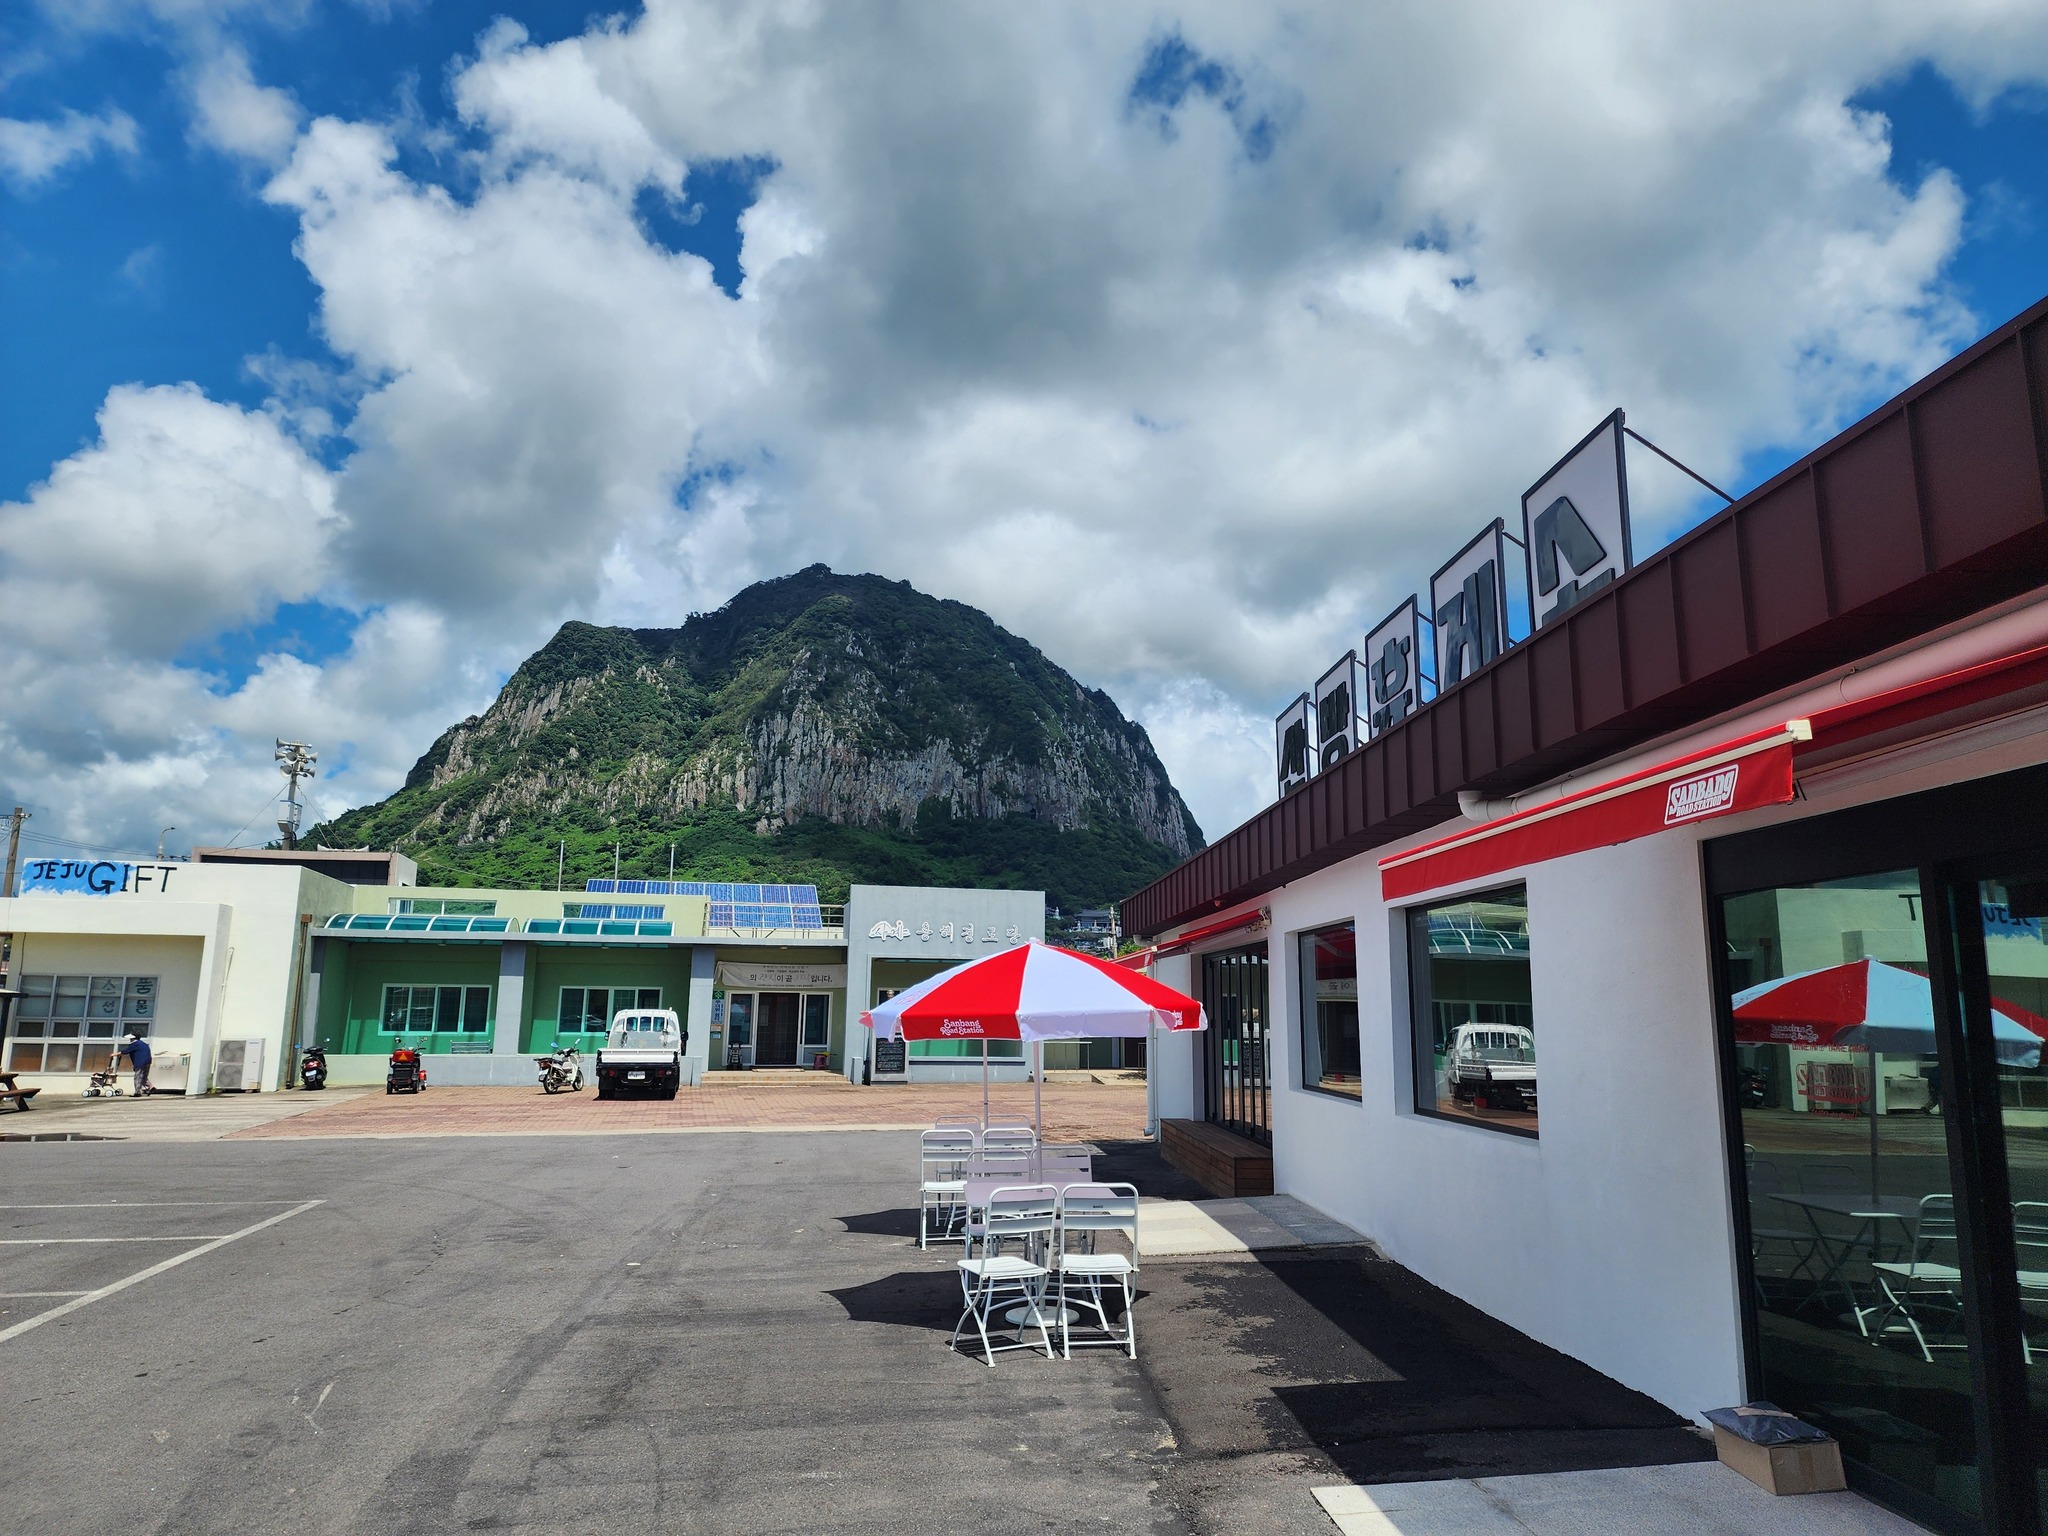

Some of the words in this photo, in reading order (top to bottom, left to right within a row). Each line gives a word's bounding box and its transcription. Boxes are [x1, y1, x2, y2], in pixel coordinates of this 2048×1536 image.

[1675, 803, 1694, 817] ROAD
[1693, 795, 1722, 813] STATION
[33, 862, 88, 880] JEJU
[87, 861, 178, 895] GIFT
[939, 1026, 959, 1036] Road
[958, 1026, 985, 1036] Station
[943, 1018, 981, 1029] Sanbang
